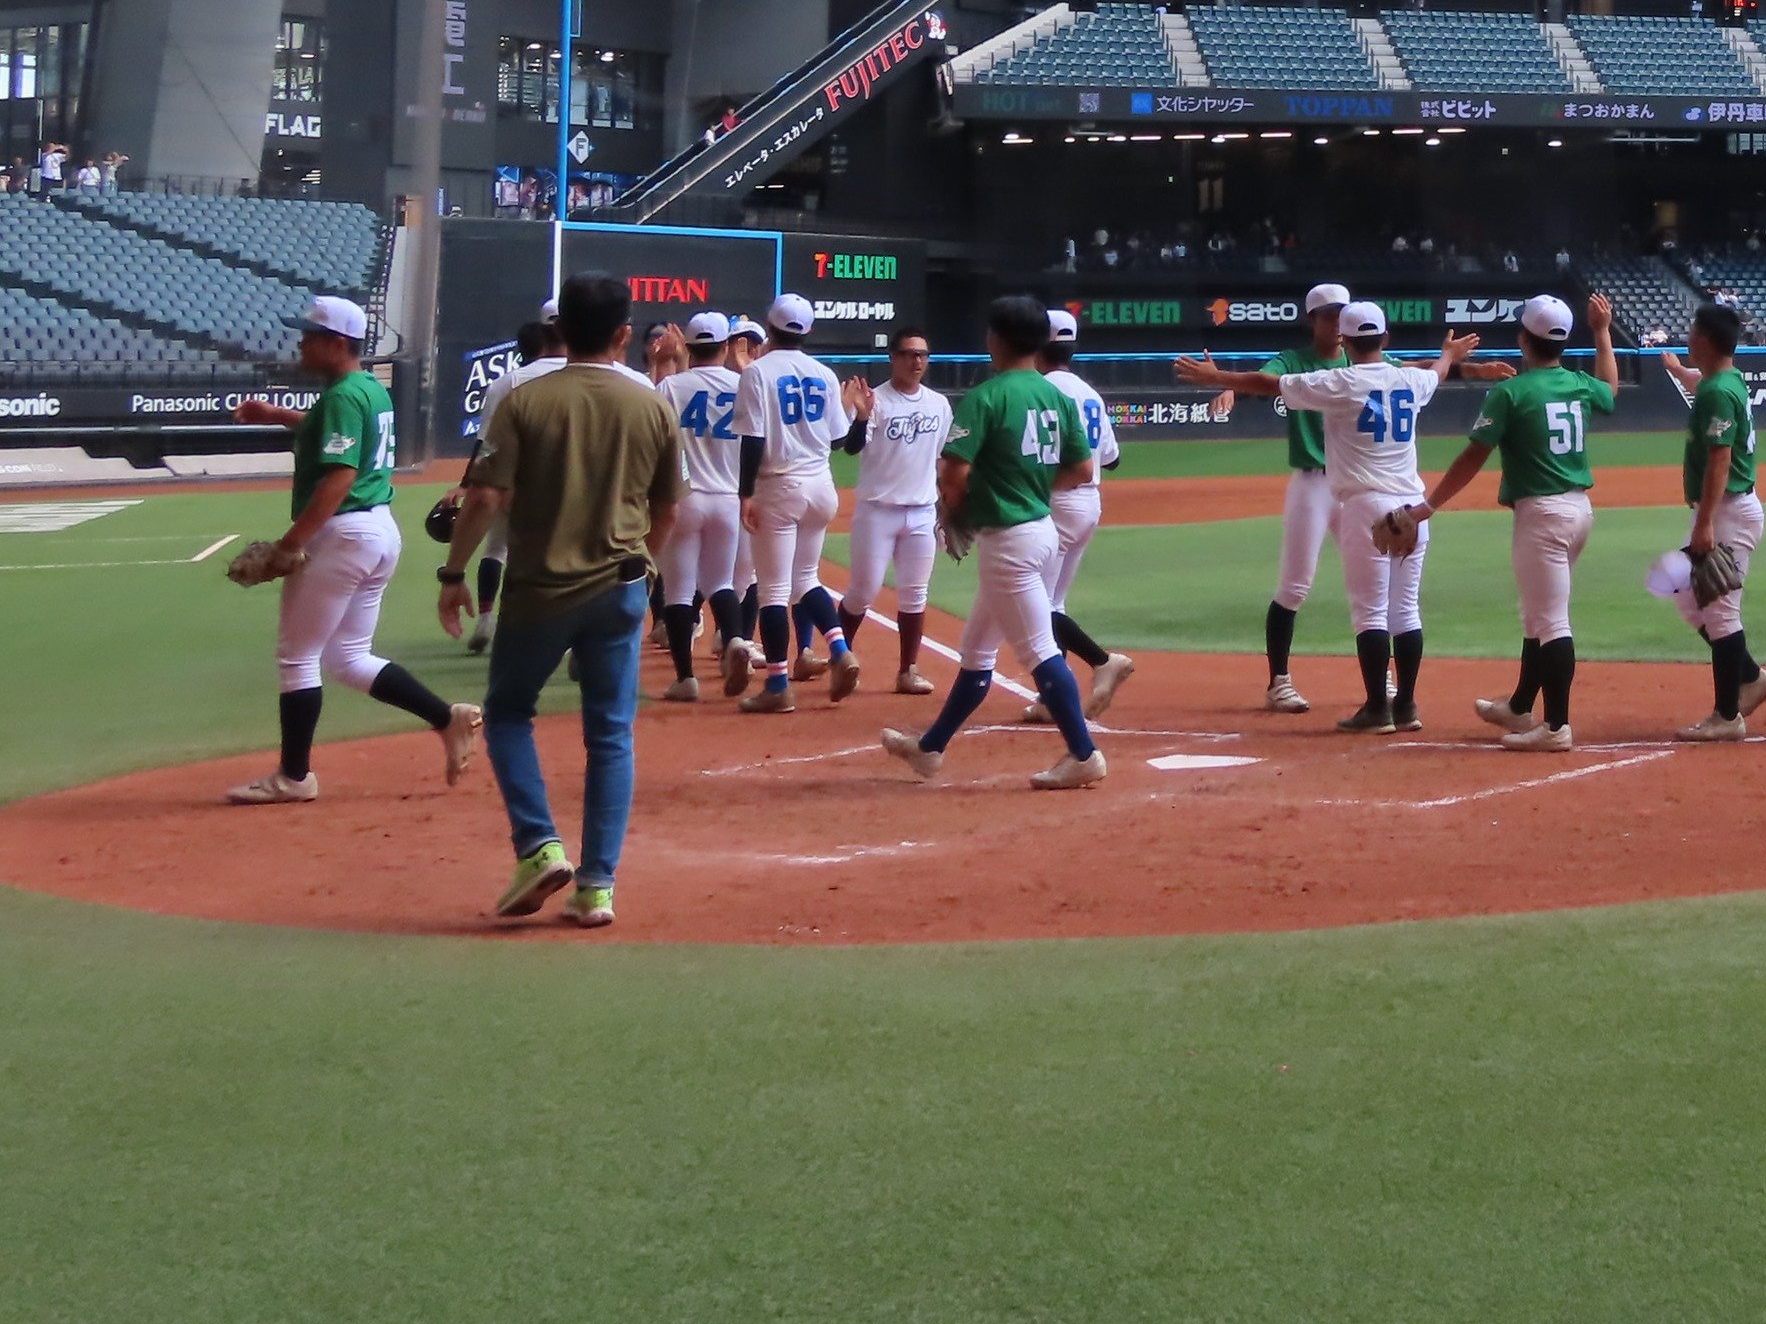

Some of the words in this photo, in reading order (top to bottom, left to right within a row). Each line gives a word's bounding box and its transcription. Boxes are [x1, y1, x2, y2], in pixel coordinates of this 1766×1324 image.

[823, 21, 923, 112] FUJITEC
[265, 113, 321, 138] FLAG
[1285, 96, 1394, 117] TOPPAN
[1563, 102, 1655, 120] まつおかまん
[627, 276, 708, 303] ITTAN
[1228, 302, 1298, 321] sato
[132, 393, 221, 414] Panasonic
[680, 390, 738, 440] 42
[777, 375, 826, 425] 66
[1357, 389, 1414, 443] 46
[1020, 408, 1061, 465] 43
[1546, 401, 1584, 455] 51
